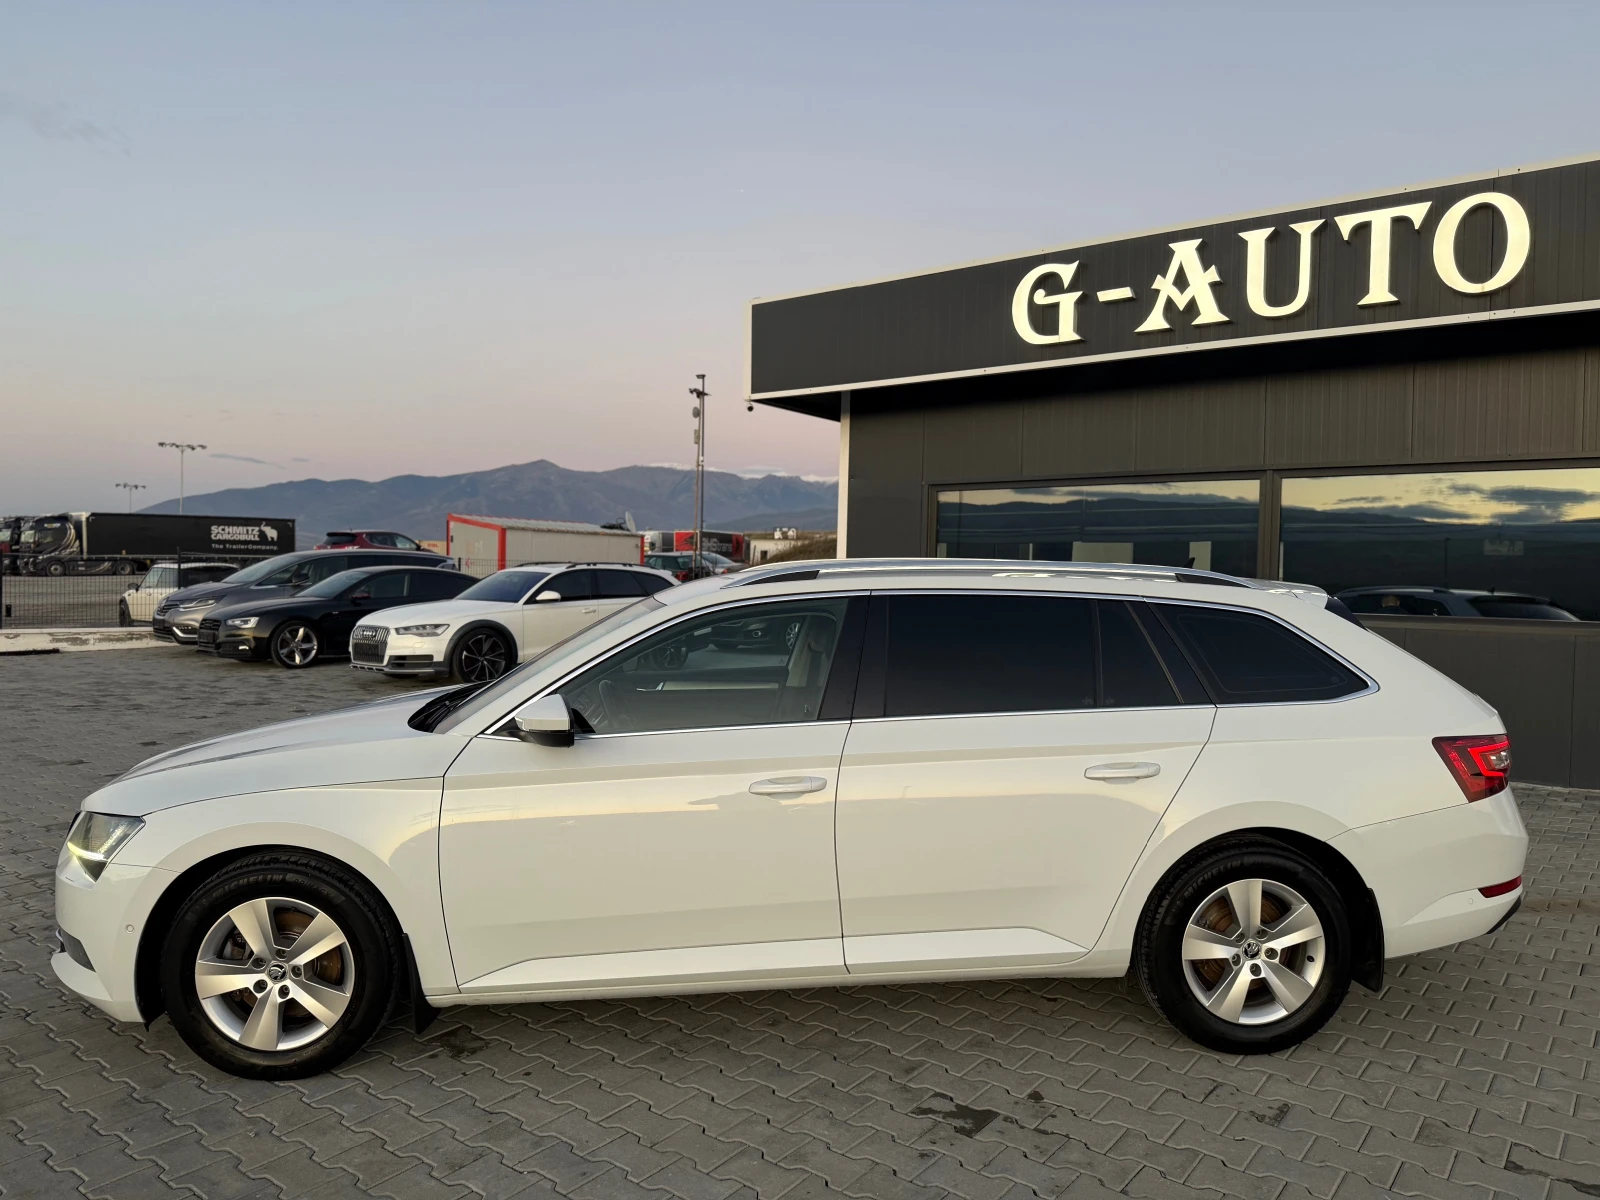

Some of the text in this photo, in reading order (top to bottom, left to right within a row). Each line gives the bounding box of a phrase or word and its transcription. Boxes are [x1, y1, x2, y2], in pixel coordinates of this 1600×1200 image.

[1011, 191, 1531, 346] G-AUTO
[210, 525, 260, 535] SCHMITZ
[210, 533, 260, 541] CARGOBULL
[212, 873, 284, 898] MICHELIN
[1184, 859, 1242, 899] MICHELIN
